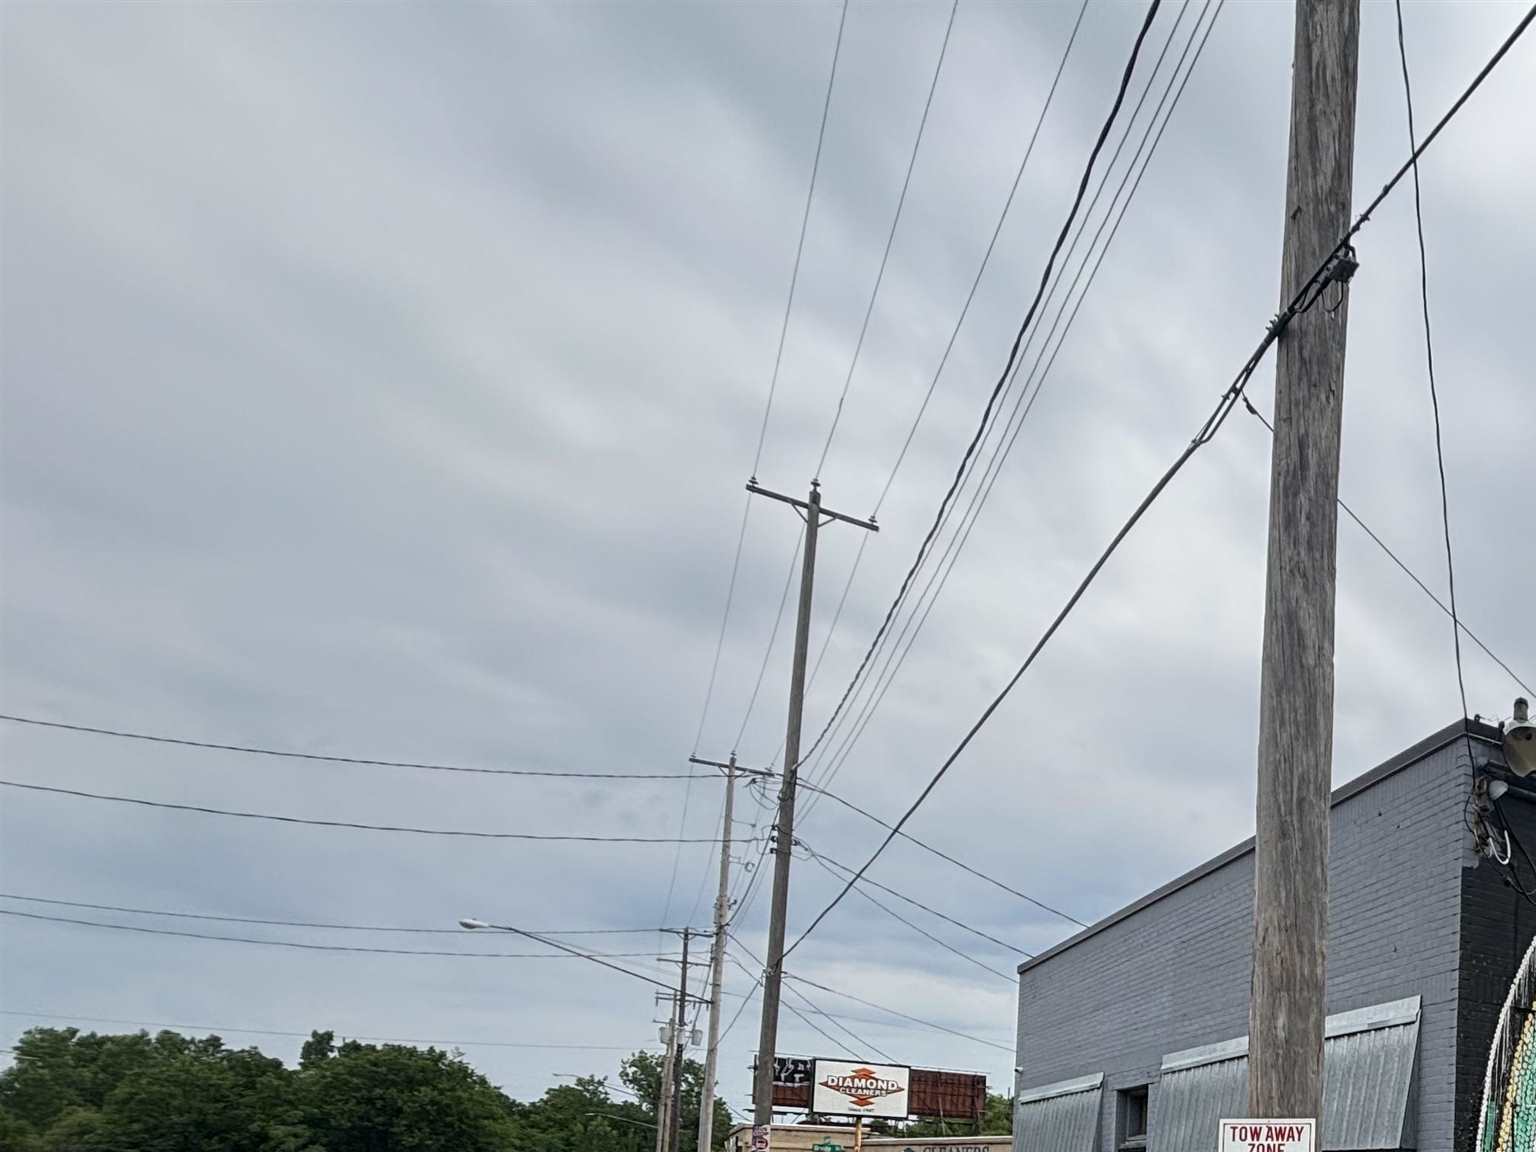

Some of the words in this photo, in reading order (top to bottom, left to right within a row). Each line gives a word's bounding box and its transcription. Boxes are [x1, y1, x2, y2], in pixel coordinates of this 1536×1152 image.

[827, 1075, 899, 1090] DIAMOND
[839, 1087, 888, 1097] CLEANERS
[1230, 1126, 1262, 1142] TOW
[1265, 1126, 1304, 1142] AWAY
